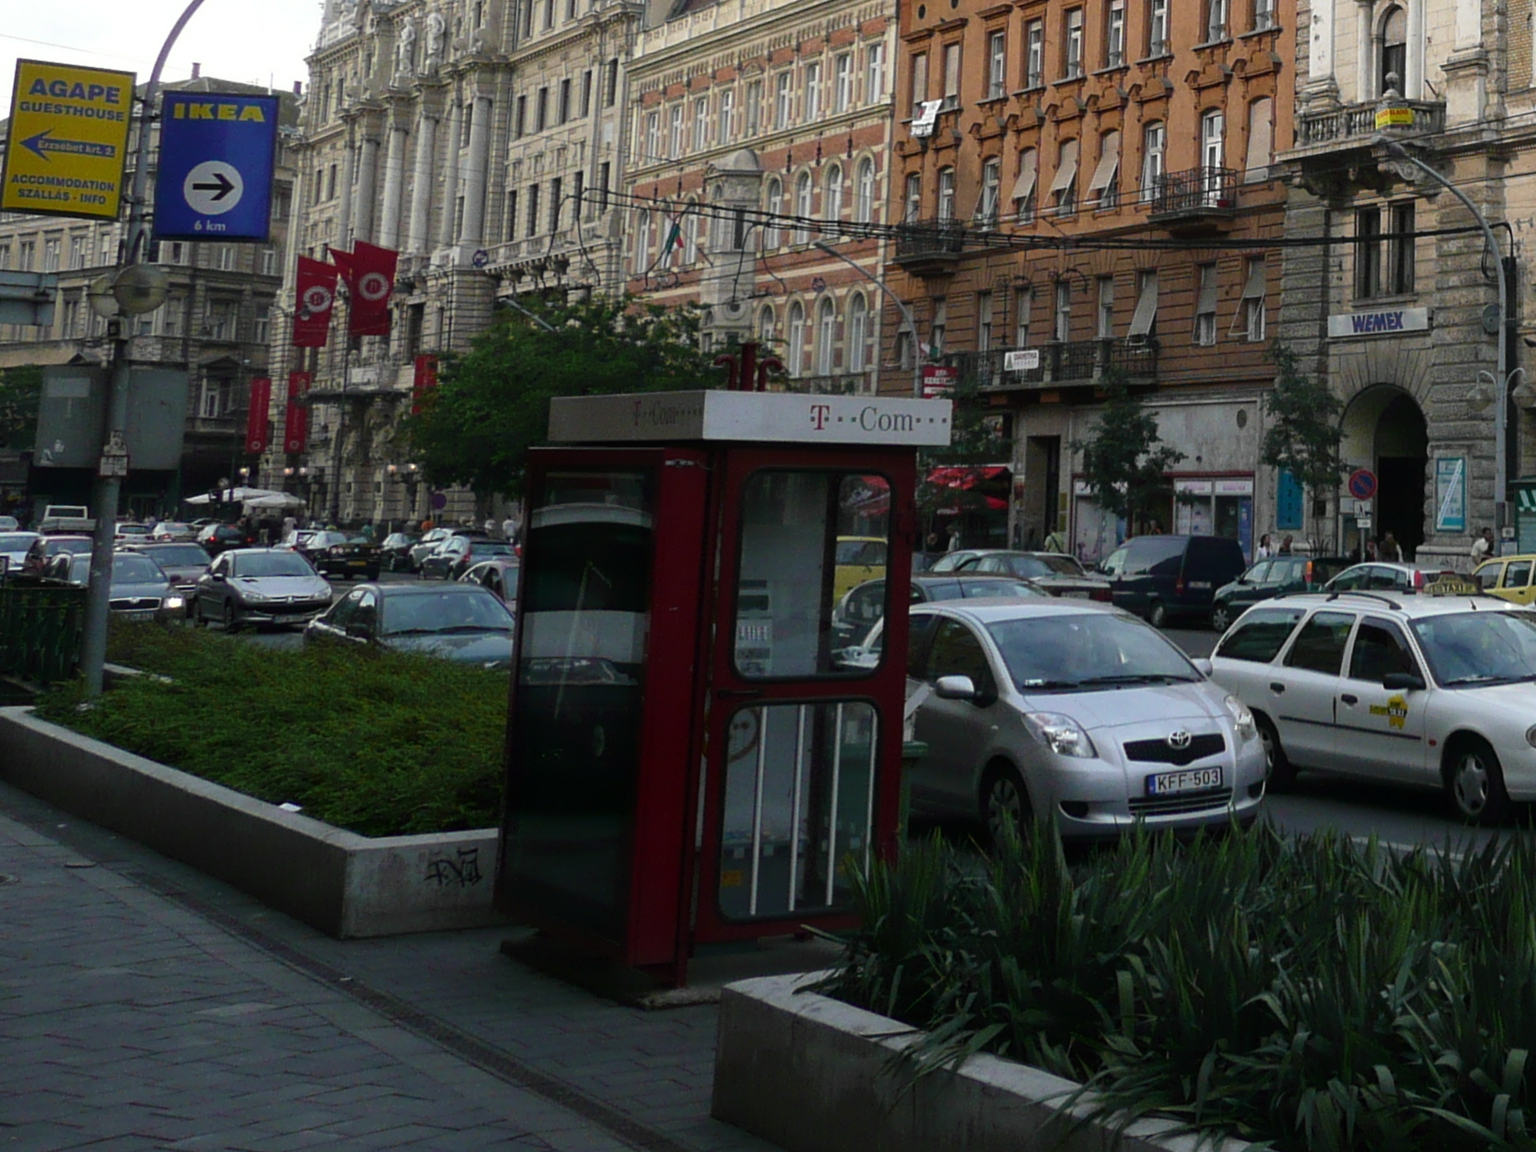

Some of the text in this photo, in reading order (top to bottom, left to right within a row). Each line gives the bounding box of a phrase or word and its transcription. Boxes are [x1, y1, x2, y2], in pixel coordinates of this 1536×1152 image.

[28, 78, 121, 104] AGAPE
[19, 101, 125, 122] GUESTHOUSE
[173, 102, 266, 123] IKEA
[85, 144, 102, 154] krt.
[105, 147, 114, 156] 2.
[11, 174, 115, 192] ACCOMMODATION
[18, 186, 71, 202] SZÁLLÁS
[80, 193, 106, 205] INFO
[194, 219, 226, 231] 6 km
[1351, 311, 1404, 333] WEMEX
[859, 406, 914, 432] Com
[1157, 769, 1219, 790] KFF-503
